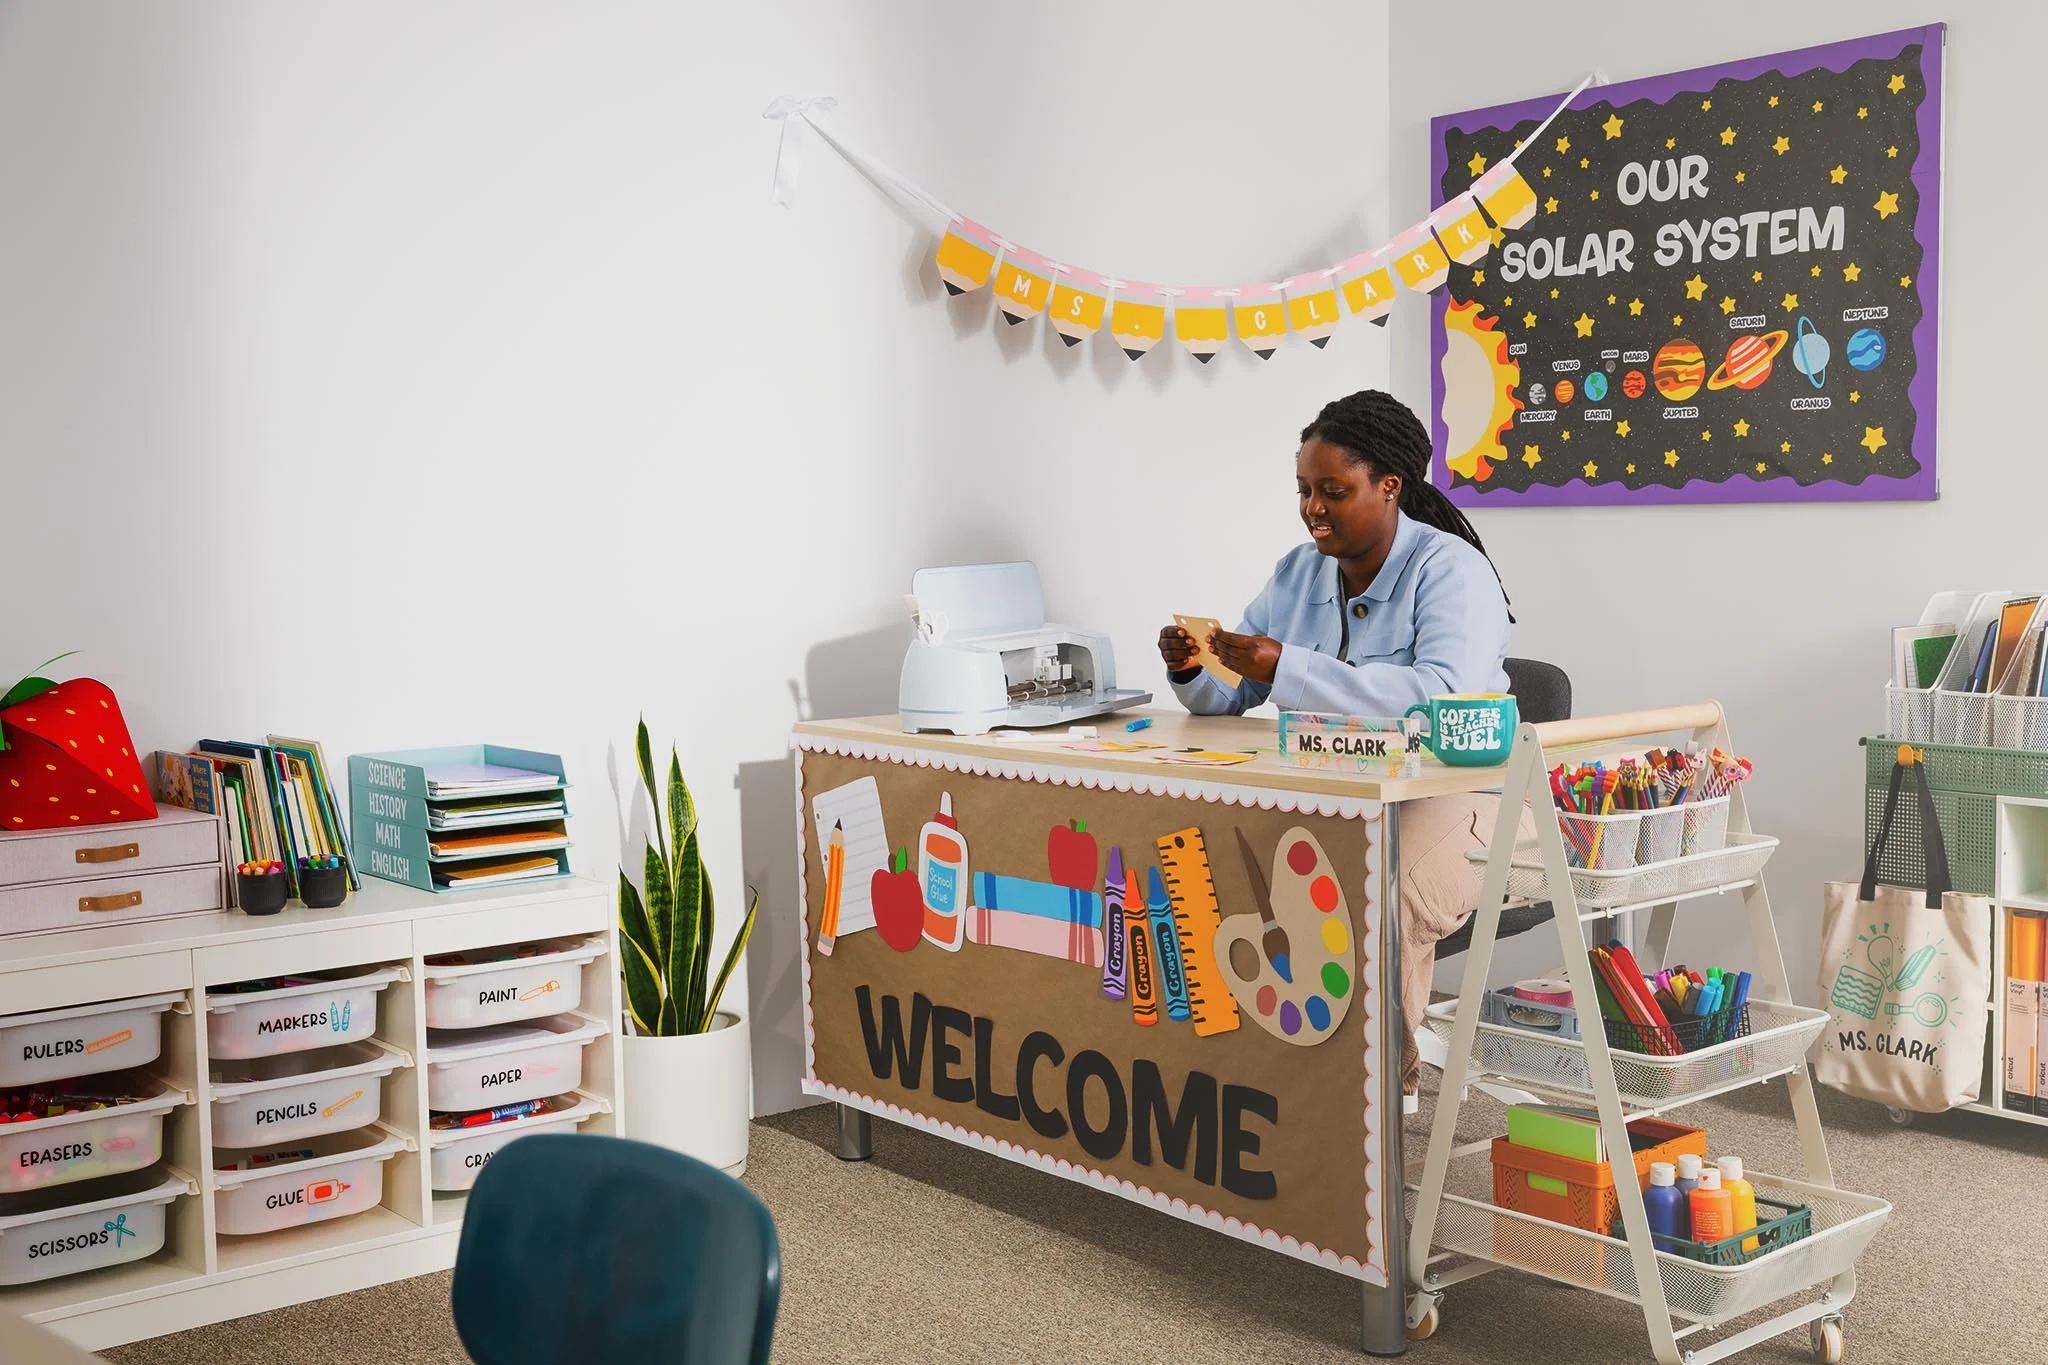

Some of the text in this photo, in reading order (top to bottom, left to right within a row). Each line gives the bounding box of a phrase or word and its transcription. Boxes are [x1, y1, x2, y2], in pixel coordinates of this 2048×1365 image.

[1617, 155, 1709, 205] OUR
[1500, 206, 1845, 283] SOLAR SYSTEM
[1730, 317, 1765, 327] SATURN
[1844, 308, 1887, 320] NEPTUNE
[1510, 344, 1526, 354] SUN
[1602, 350, 1619, 358] MOON
[1624, 352, 1648, 362] MARS
[1553, 361, 1579, 371] VENUS
[1585, 410, 1611, 420] EARTH
[1664, 408, 1698, 418] JUPITER
[1792, 399, 1830, 409] URANUS
[1521, 411, 1556, 421] MERCURY
[1439, 708, 1501, 725] COFFEE
[1451, 718, 1501, 736] TEACHER
[1299, 735, 1327, 753] MS.
[1332, 738, 1387, 757] CLARK
[1440, 728, 1501, 750] FUEL
[368, 761, 406, 791] SCIENCE
[369, 792, 407, 821] HISTORY
[375, 821, 401, 849] MATH
[371, 850, 410, 881] ENGLISH
[930, 867, 952, 890] School
[930, 884, 948, 903] Glue
[1110, 913, 1123, 971] Crayon
[1135, 935, 1149, 994] Crayon
[1162, 931, 1180, 991] Crayon
[479, 987, 518, 1005] PAINT
[258, 1012, 327, 1036] MARKERS
[23, 1039, 85, 1061] RULERS
[1838, 1030, 1938, 1065] MS. CLARK
[481, 1068, 522, 1088] PAPER
[854, 985, 1279, 1200] WELCOME
[256, 1101, 317, 1125] PENCILS
[20, 1142, 92, 1168] ERASERS
[266, 1189, 304, 1209] GLUE
[28, 1230, 109, 1259] SCISSORS
